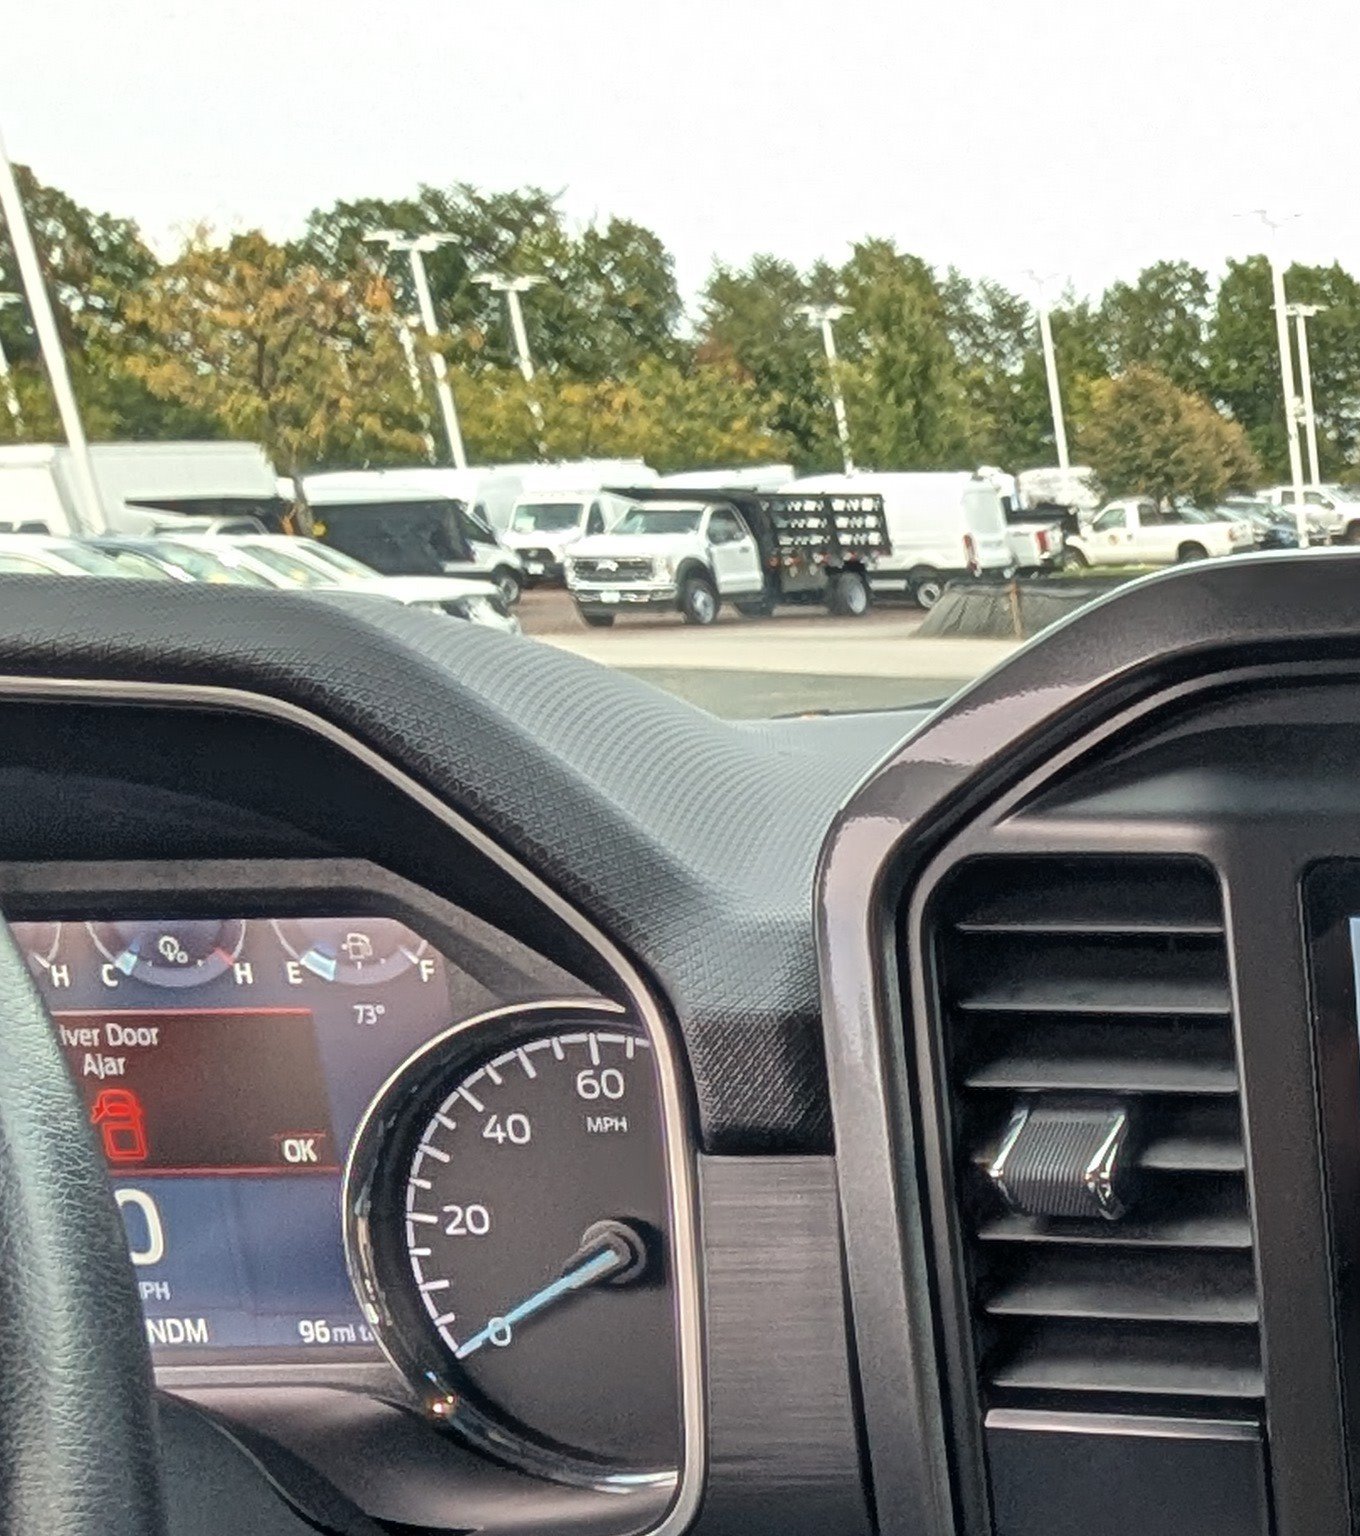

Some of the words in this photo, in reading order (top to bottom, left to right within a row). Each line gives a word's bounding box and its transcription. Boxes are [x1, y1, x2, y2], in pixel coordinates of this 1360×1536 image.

[51, 964, 70, 987] H
[102, 964, 118, 987] C
[234, 963, 253, 984] H
[286, 961, 303, 984] E
[419, 959, 434, 982] F
[353, 1004, 385, 1024] 73°
[105, 1023, 159, 1046] Door
[83, 1053, 126, 1079] Ajar
[576, 1068, 625, 1099] 60
[482, 1113, 531, 1145] 40
[586, 1116, 628, 1133] MPH
[283, 1139, 317, 1162] OK
[443, 1205, 490, 1235] 20
[141, 1281, 171, 1300] PH
[299, 1320, 331, 1343] 96
[488, 1316, 512, 1346] 0
